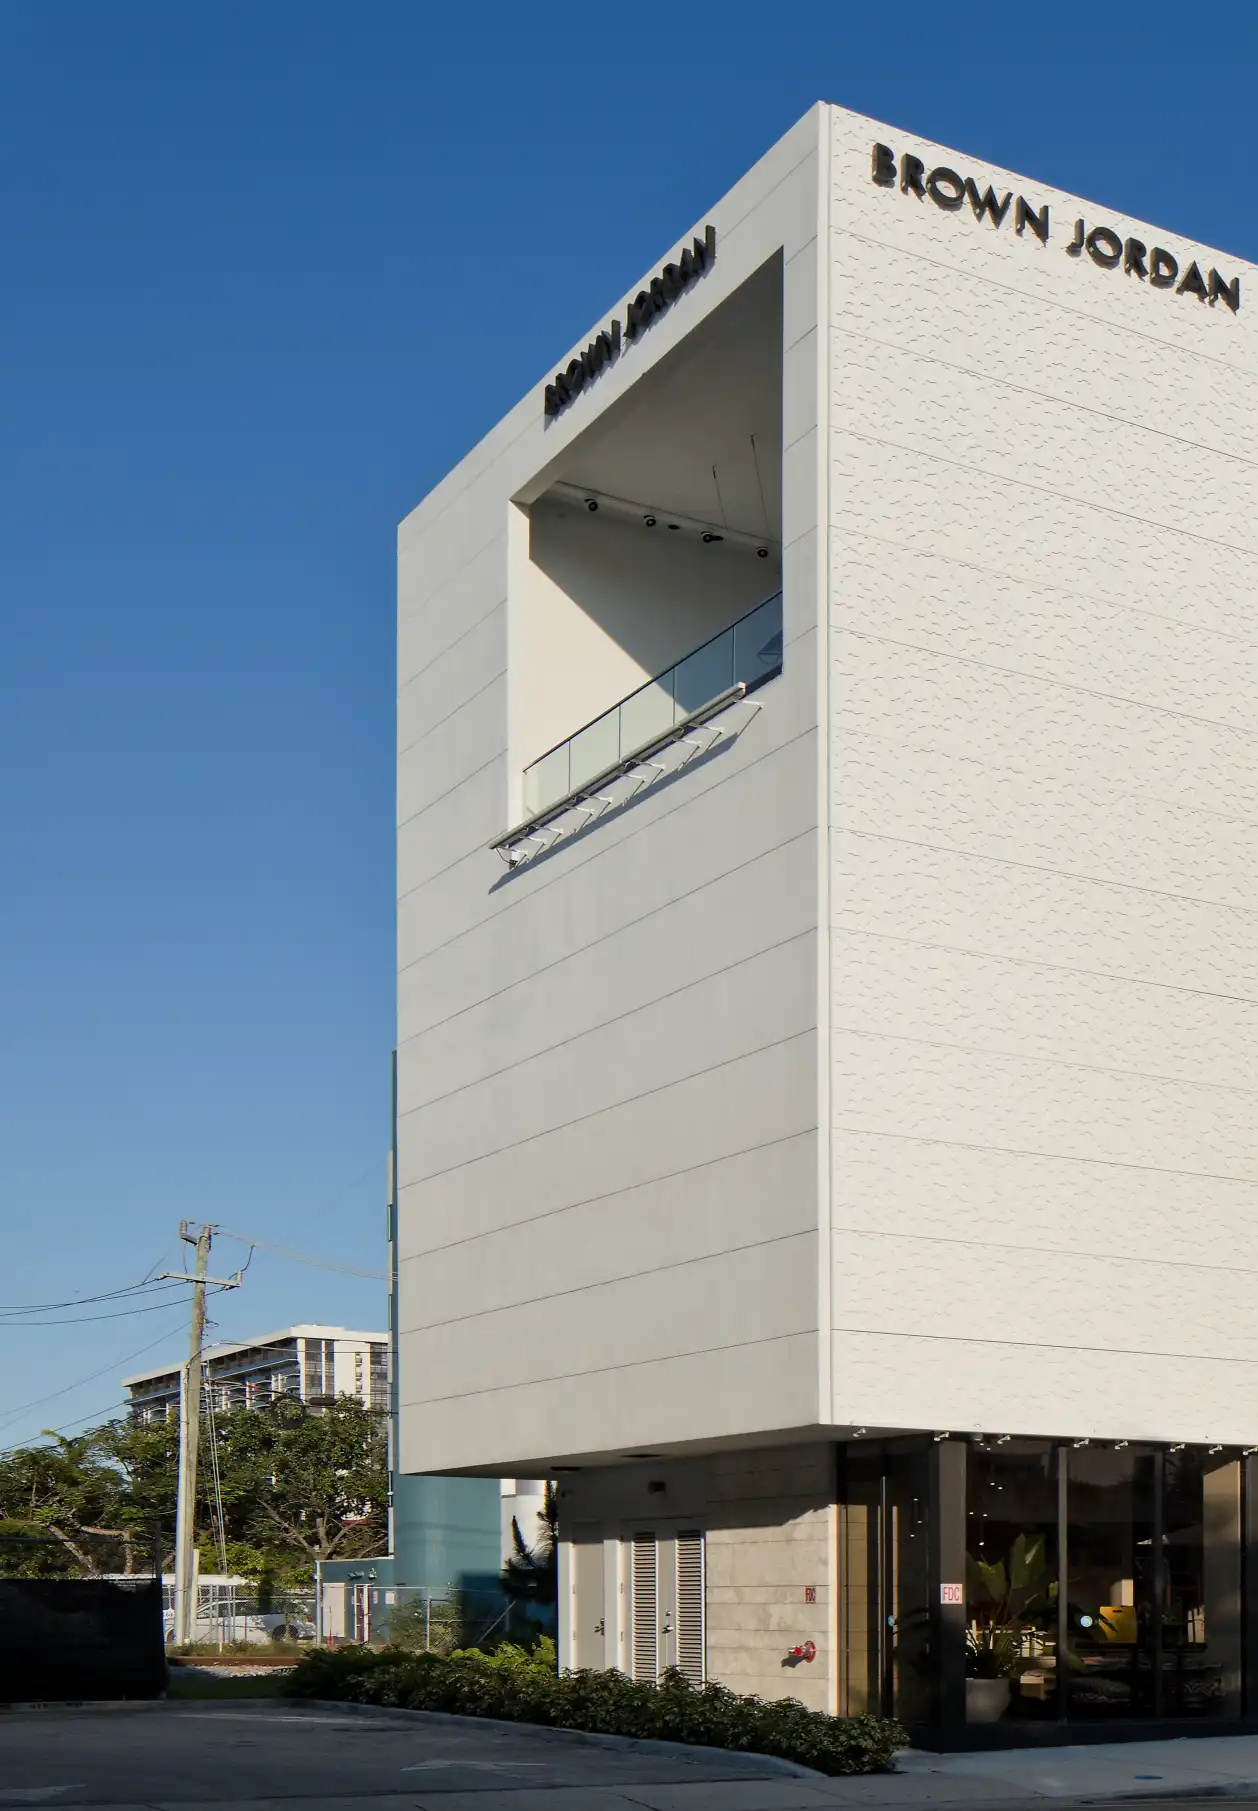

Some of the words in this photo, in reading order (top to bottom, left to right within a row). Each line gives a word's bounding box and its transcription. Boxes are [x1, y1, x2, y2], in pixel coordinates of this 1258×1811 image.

[872, 142, 1049, 246] BROWN
[1067, 218, 1240, 315] JORDAN
[805, 1586, 816, 1603] FDC
[943, 1586, 960, 1602] FDC
